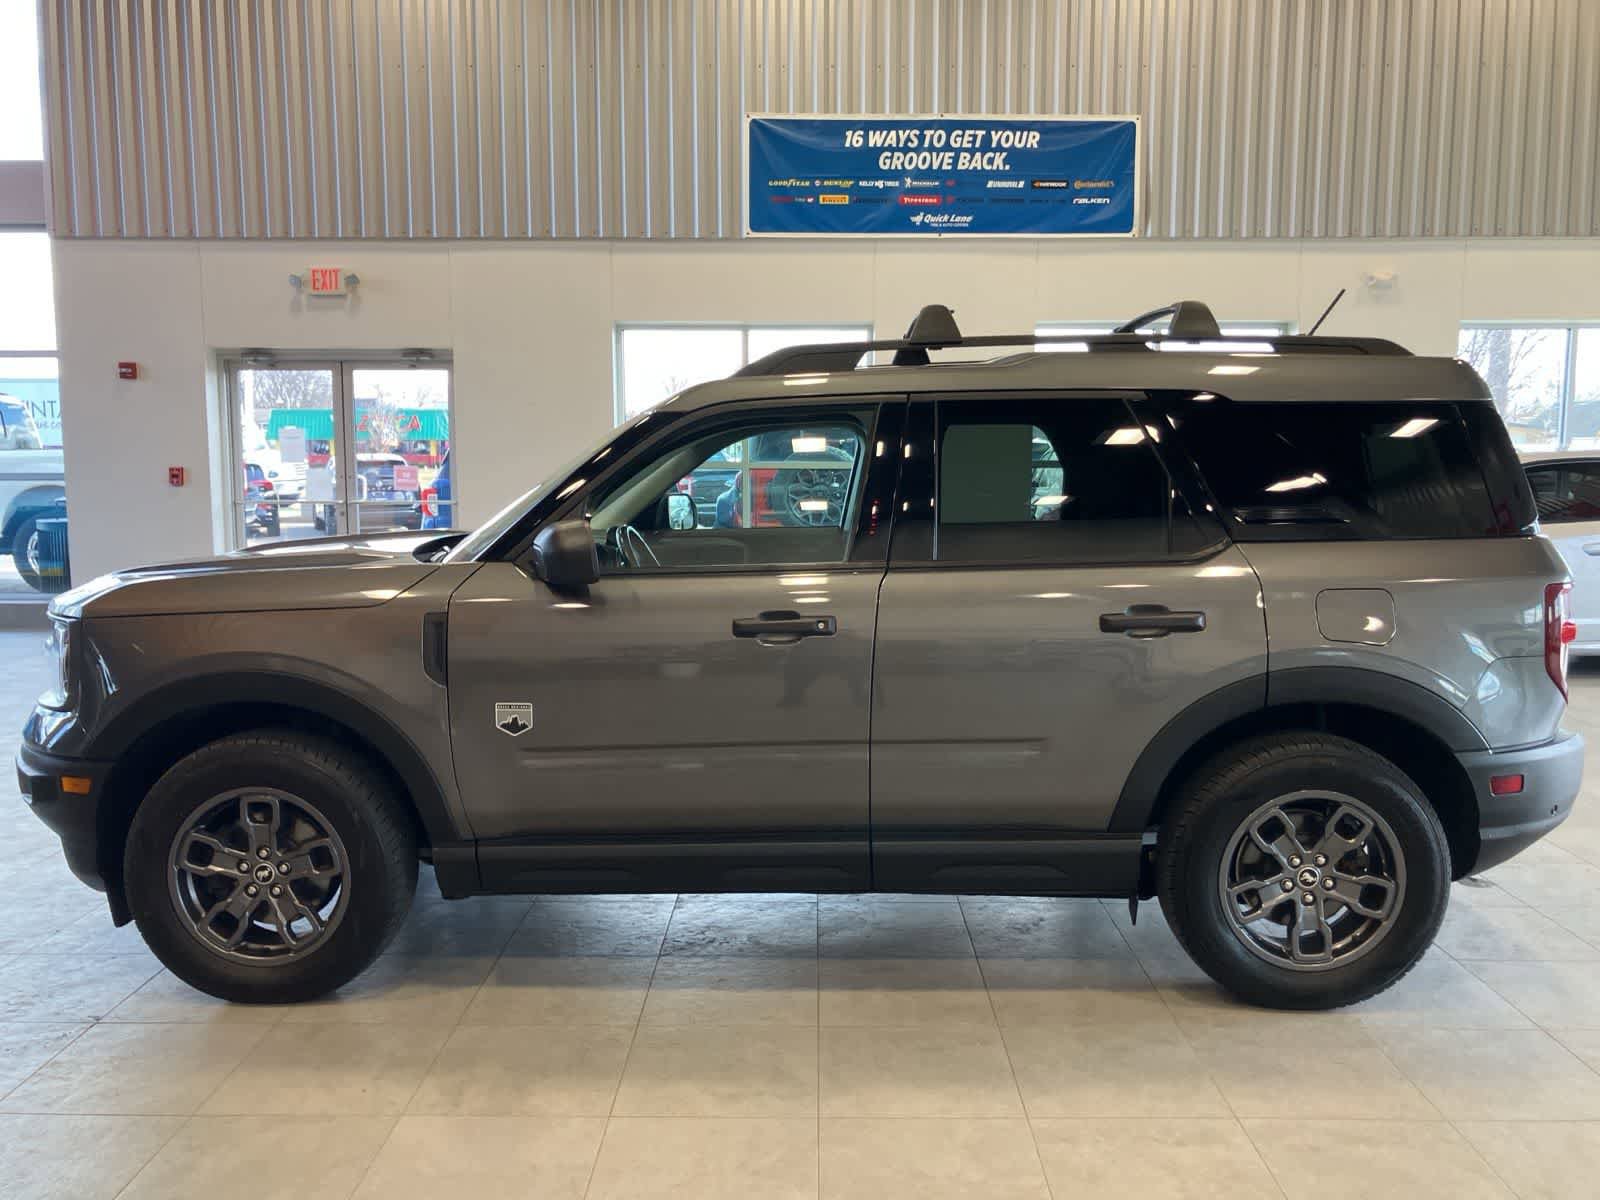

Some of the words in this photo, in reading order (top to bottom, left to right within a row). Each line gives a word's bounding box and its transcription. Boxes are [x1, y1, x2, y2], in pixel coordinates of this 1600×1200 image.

[844, 130, 864, 148] 16
[868, 130, 919, 148] WAYS
[923, 130, 946, 148] TO
[949, 130, 985, 148] GET
[990, 131, 1040, 148] YOUR
[878, 152, 955, 170] GROOVE
[957, 153, 1011, 170] BACK.
[923, 213, 950, 223] Quick
[949, 213, 974, 222] Lane
[311, 268, 340, 290] EXIT
